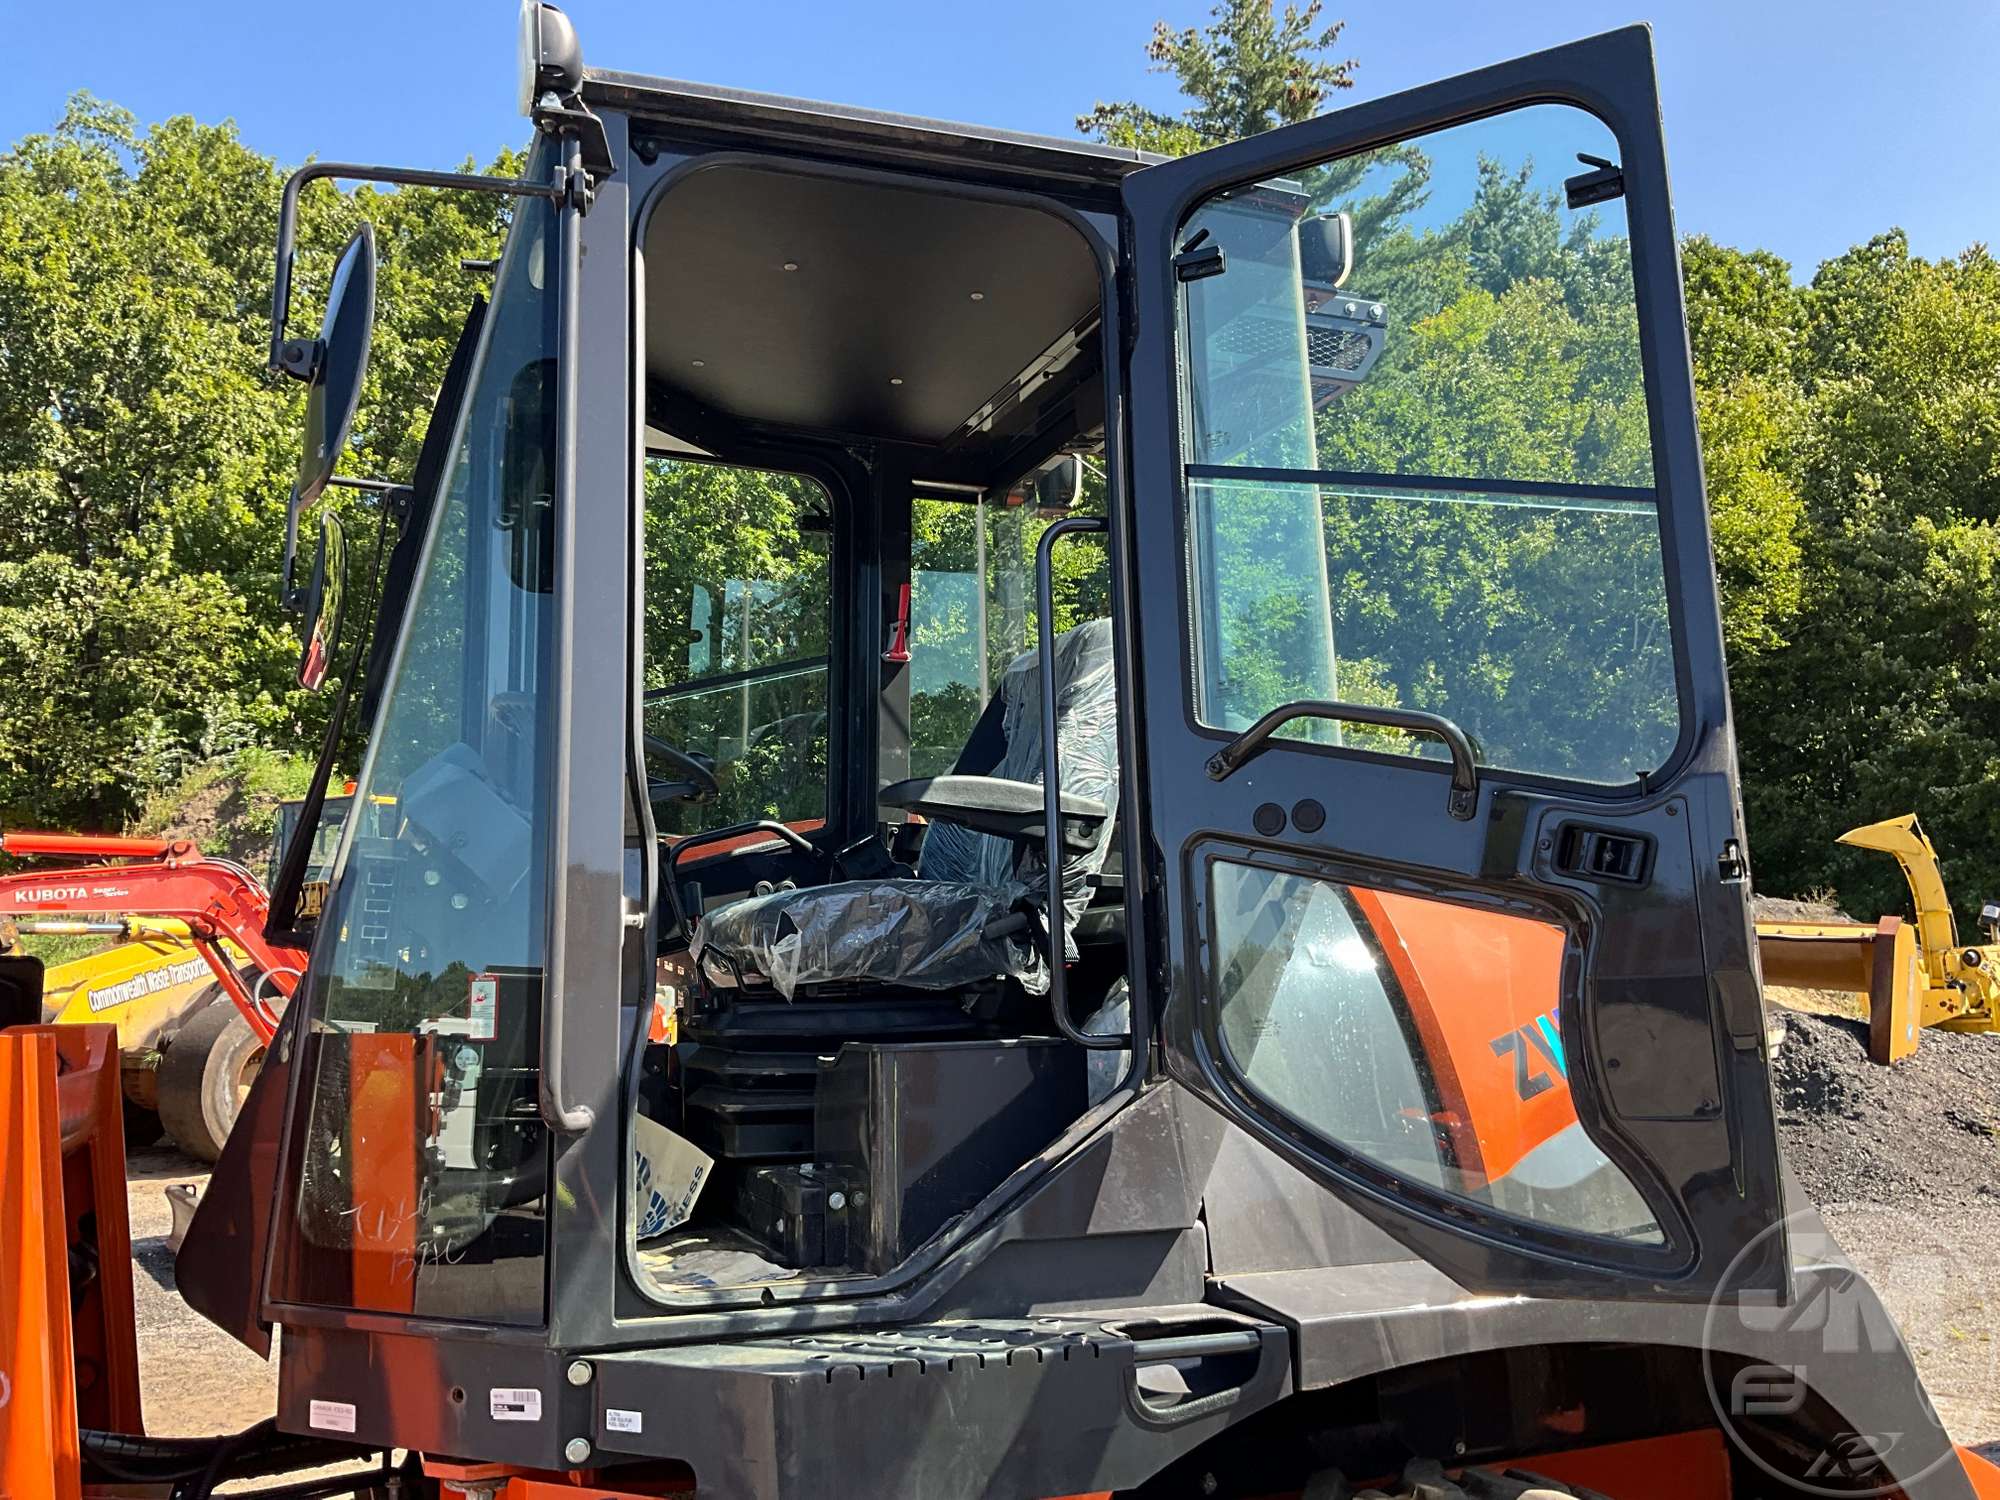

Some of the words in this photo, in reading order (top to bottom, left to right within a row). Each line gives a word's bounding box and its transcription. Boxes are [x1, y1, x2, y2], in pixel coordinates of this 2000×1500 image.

[15, 887, 88, 903] KUBOTA
[88, 973, 148, 1013] Commonwealth
[145, 967, 171, 993] Waste
